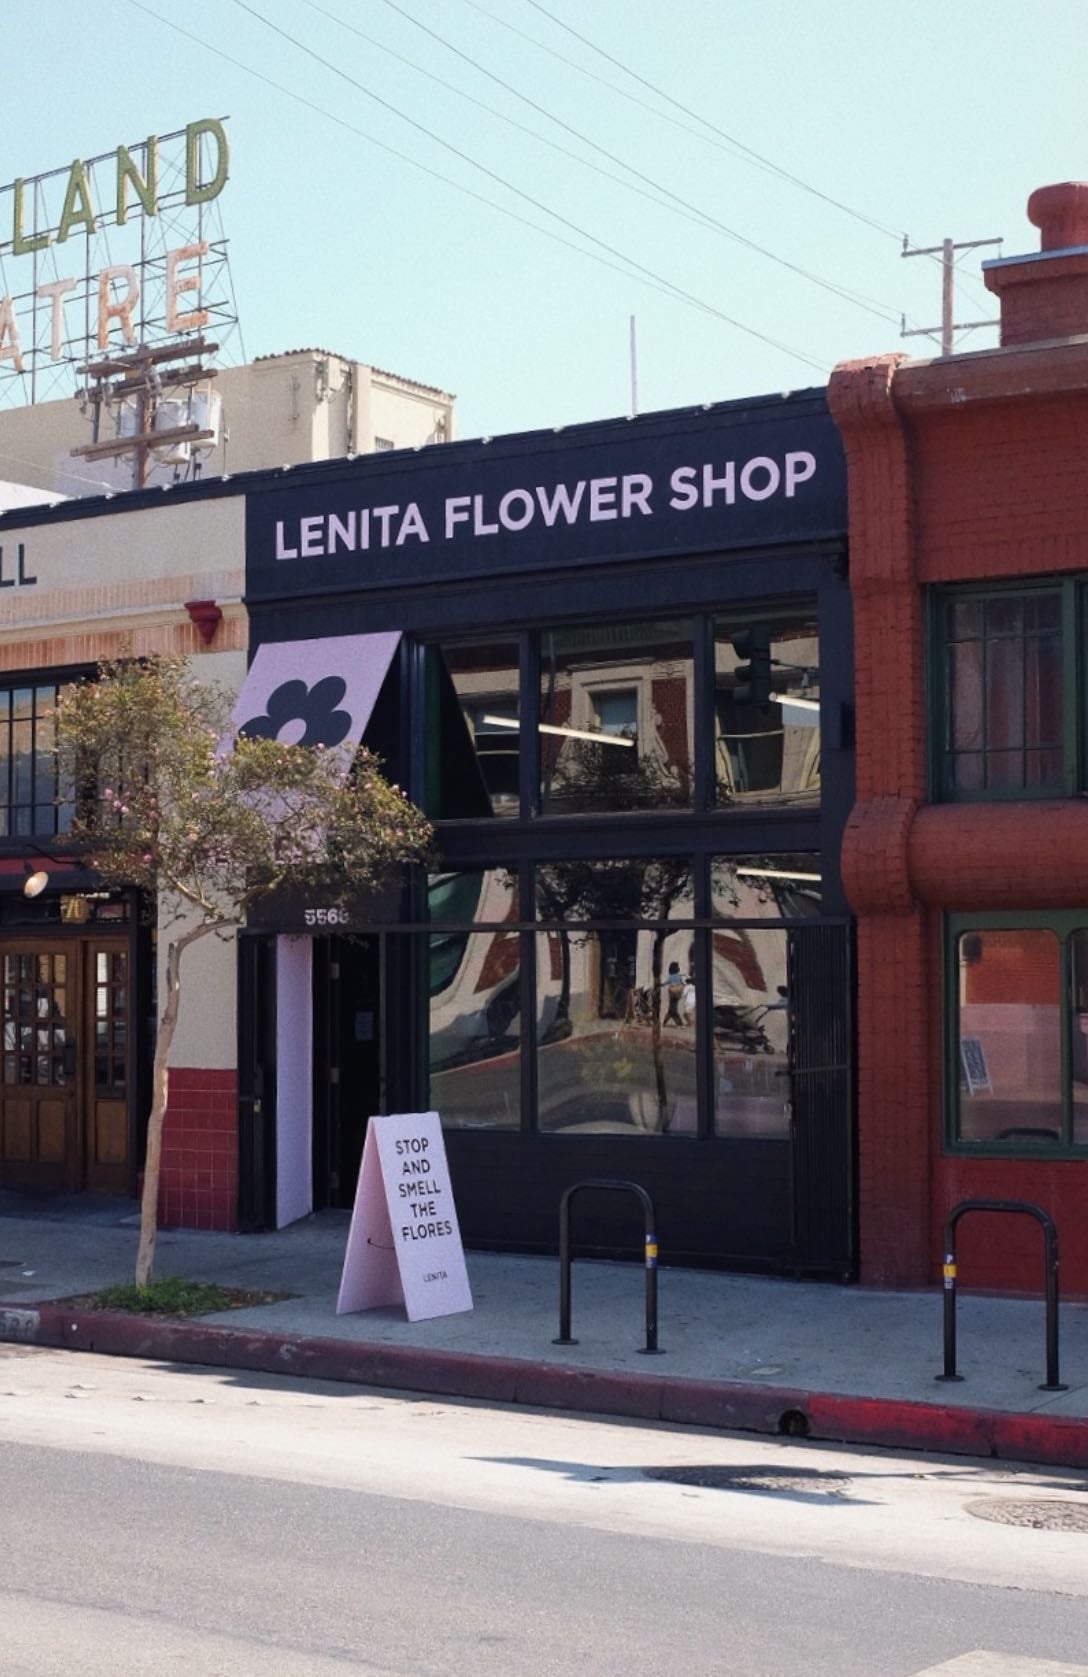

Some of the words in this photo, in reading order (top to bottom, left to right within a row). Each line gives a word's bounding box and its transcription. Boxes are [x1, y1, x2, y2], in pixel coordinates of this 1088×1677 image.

[13, 118, 230, 256] LAND
[276, 502, 429, 560] LENITA
[445, 473, 653, 538] FLOWER
[669, 451, 817, 510] SHOP
[395, 1137, 429, 1155] STOP
[402, 1159, 430, 1176] AND
[398, 1179, 441, 1198] SMELL
[410, 1201, 437, 1218] THE
[402, 1220, 453, 1241] FLORES
